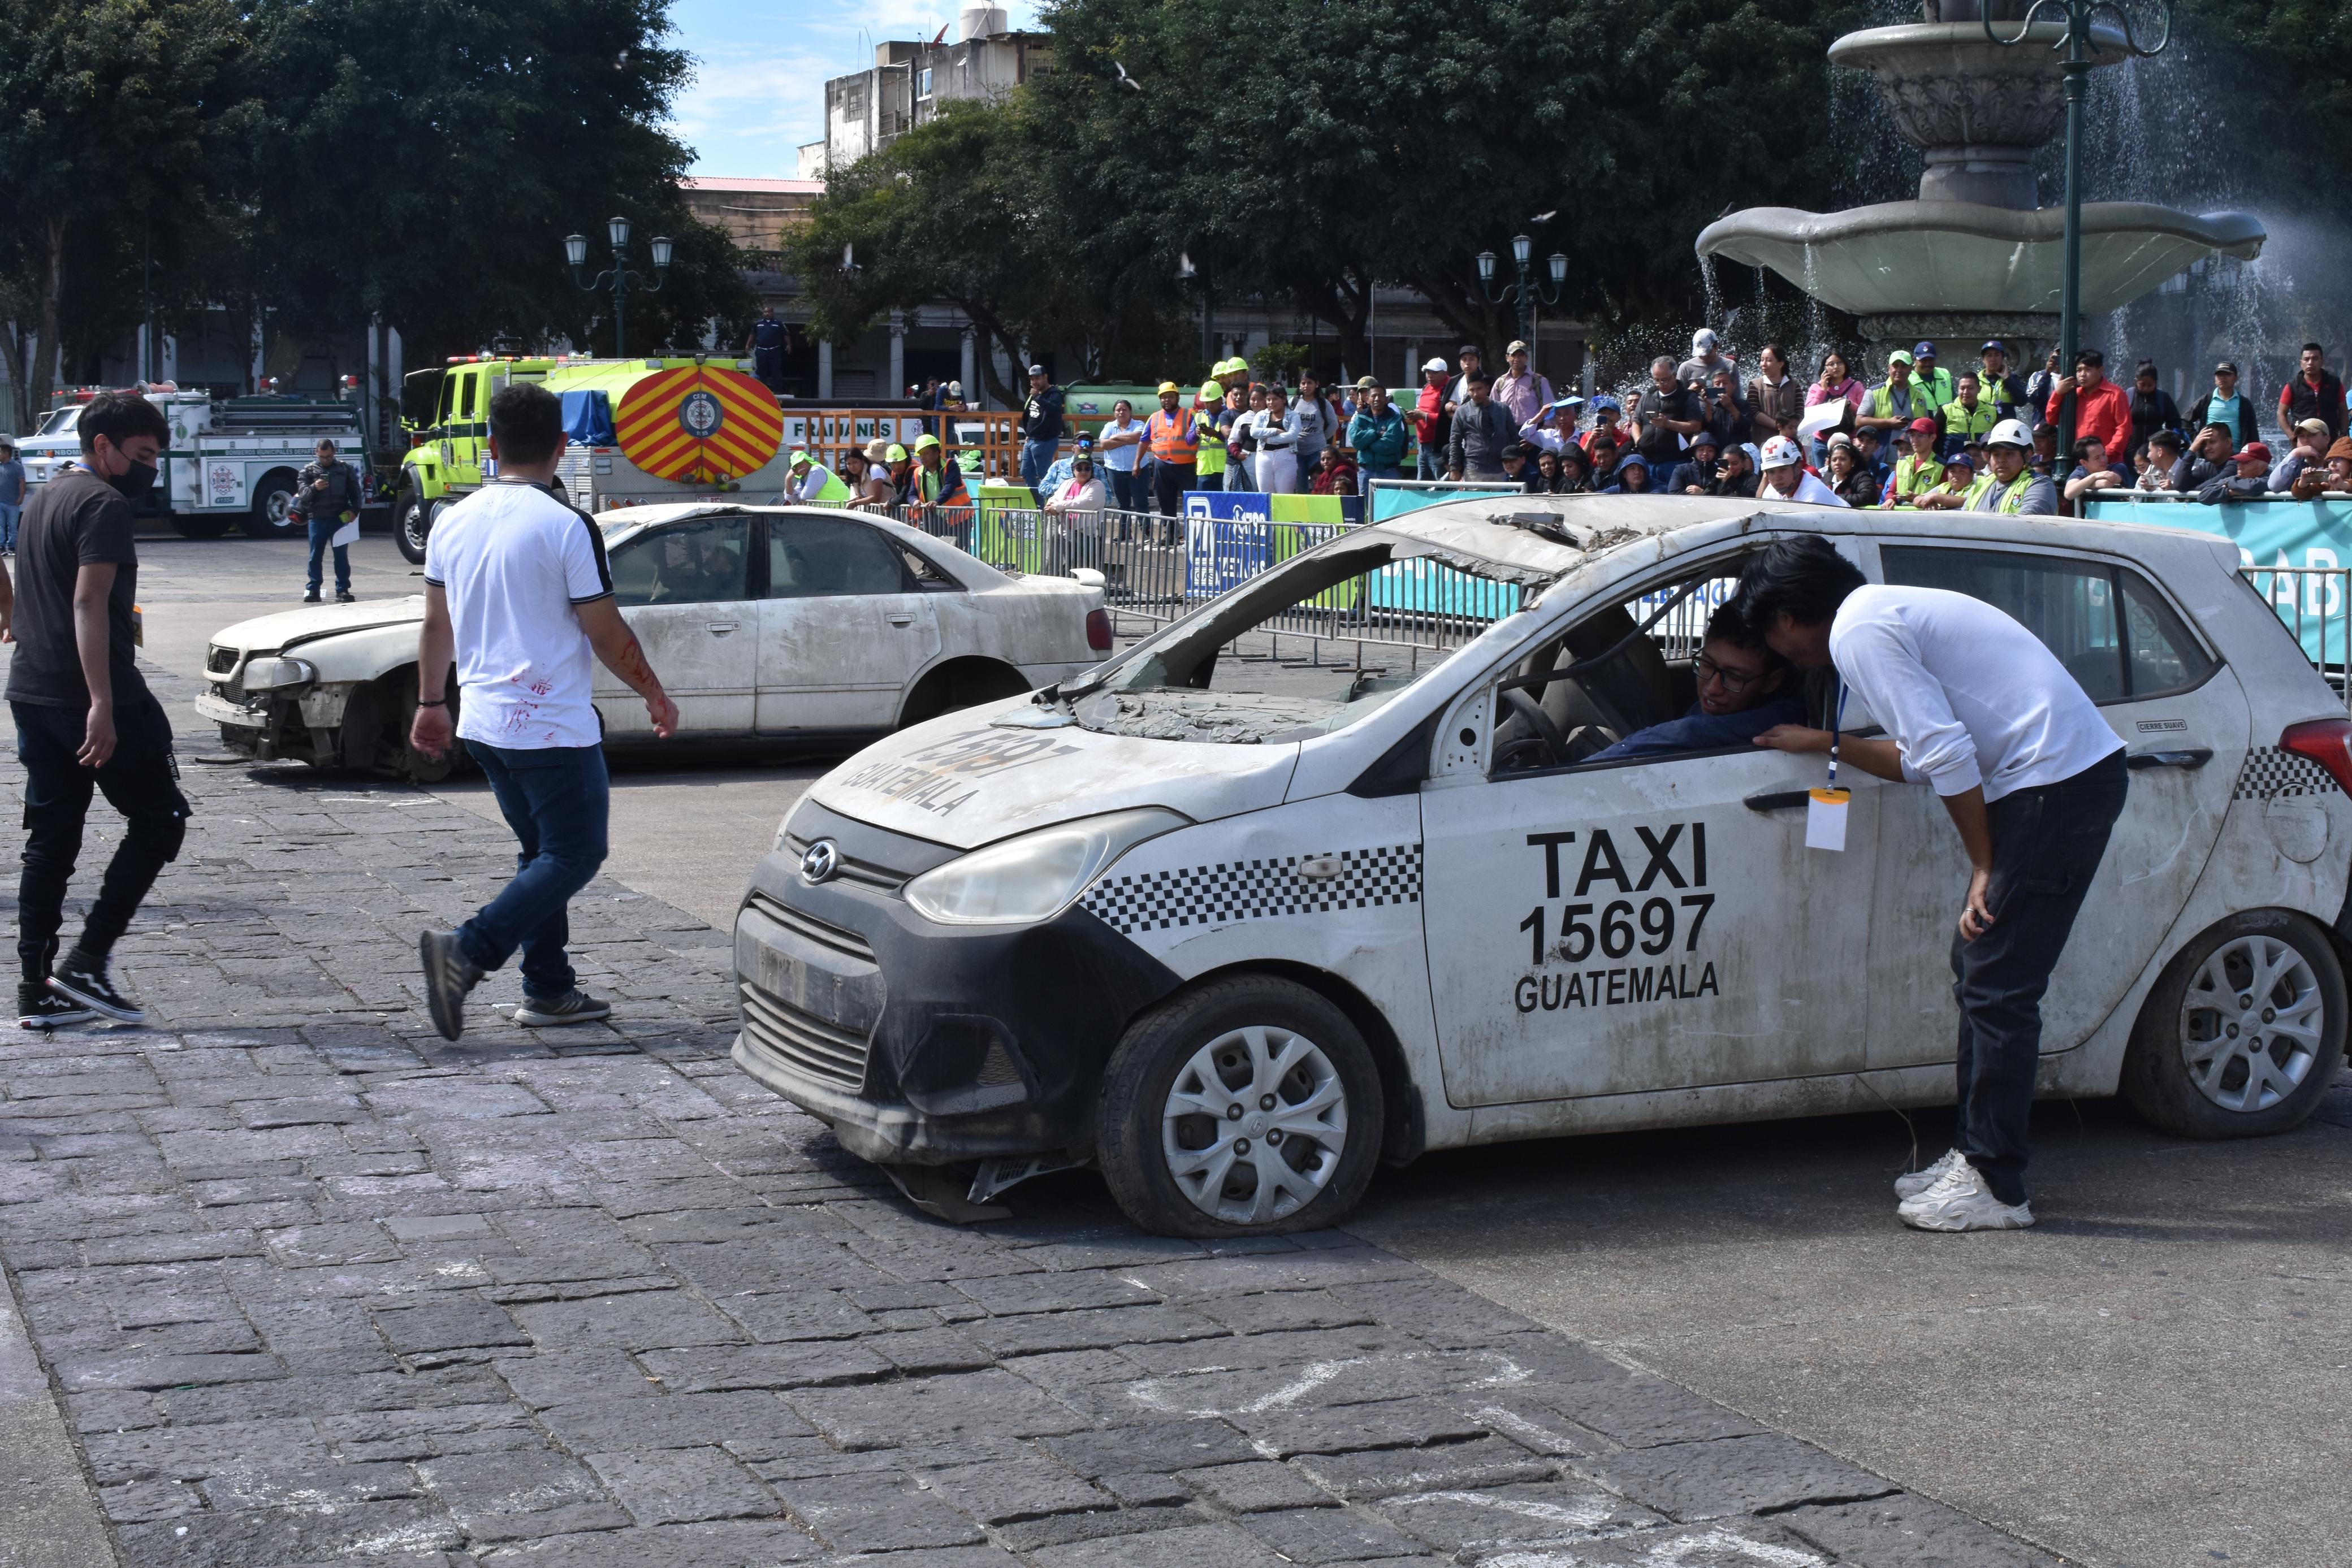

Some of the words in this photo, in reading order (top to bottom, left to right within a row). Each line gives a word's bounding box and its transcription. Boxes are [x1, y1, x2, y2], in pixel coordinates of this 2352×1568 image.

[841, 763, 980, 817] GUATEMALA
[1527, 822, 1707, 898] TAXI
[1520, 894, 1715, 965] 15697
[1514, 961, 1719, 1013] GUATEMALA
